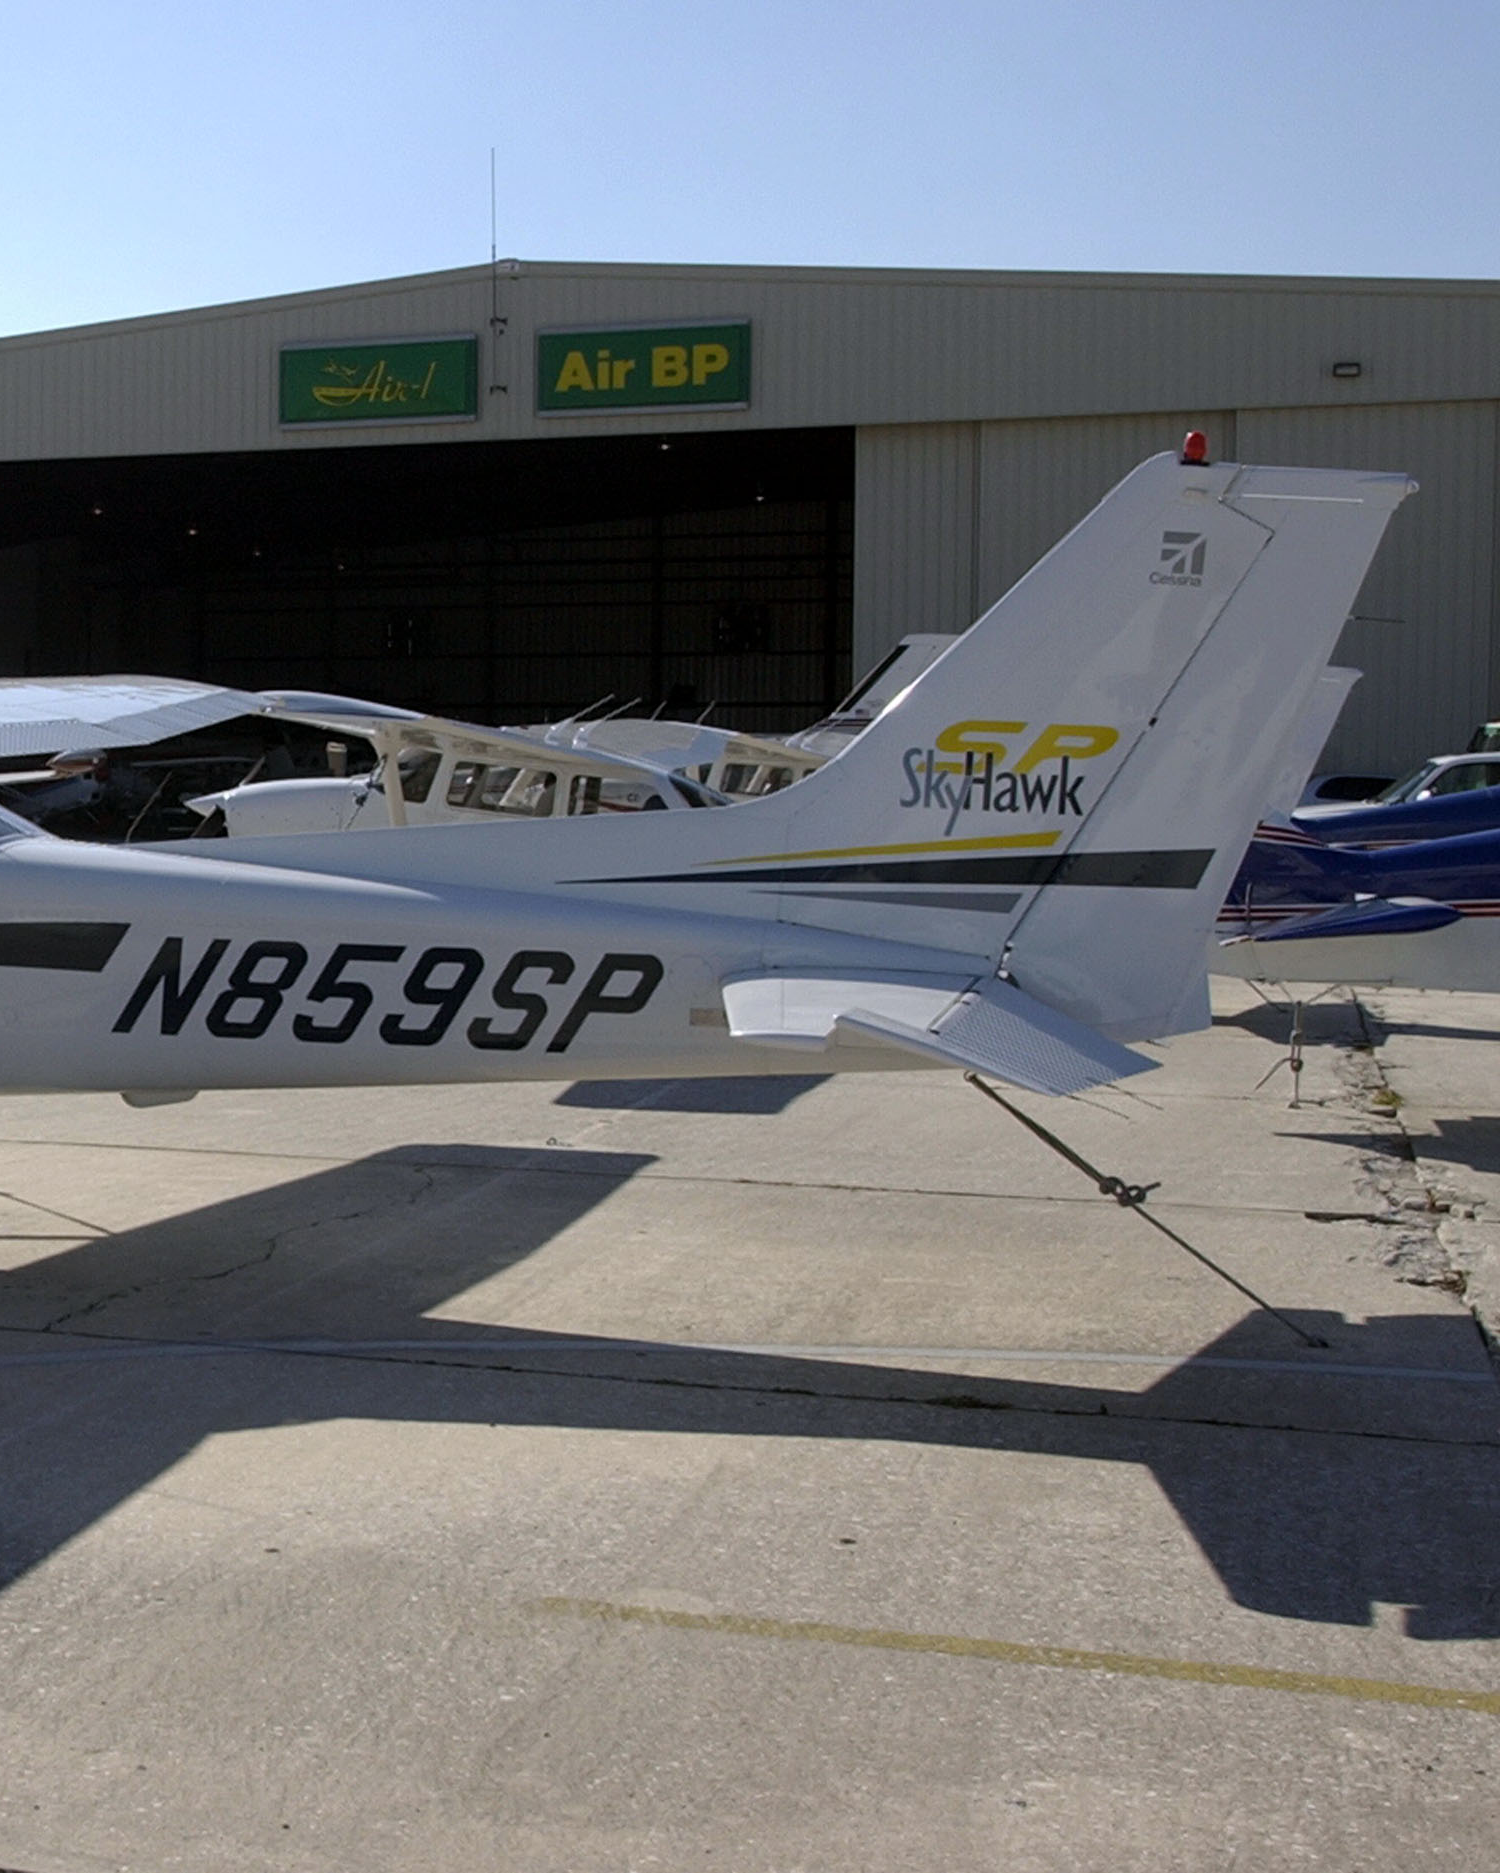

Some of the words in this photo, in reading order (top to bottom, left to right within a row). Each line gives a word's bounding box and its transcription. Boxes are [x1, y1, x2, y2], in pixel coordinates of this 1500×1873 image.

[555, 349, 636, 392] Air
[651, 343, 730, 388] BP
[1149, 571, 1202, 588] Cessna
[916, 720, 1119, 775] SP
[901, 747, 1085, 837] SkyHawk
[111, 936, 664, 1054] N859SP
